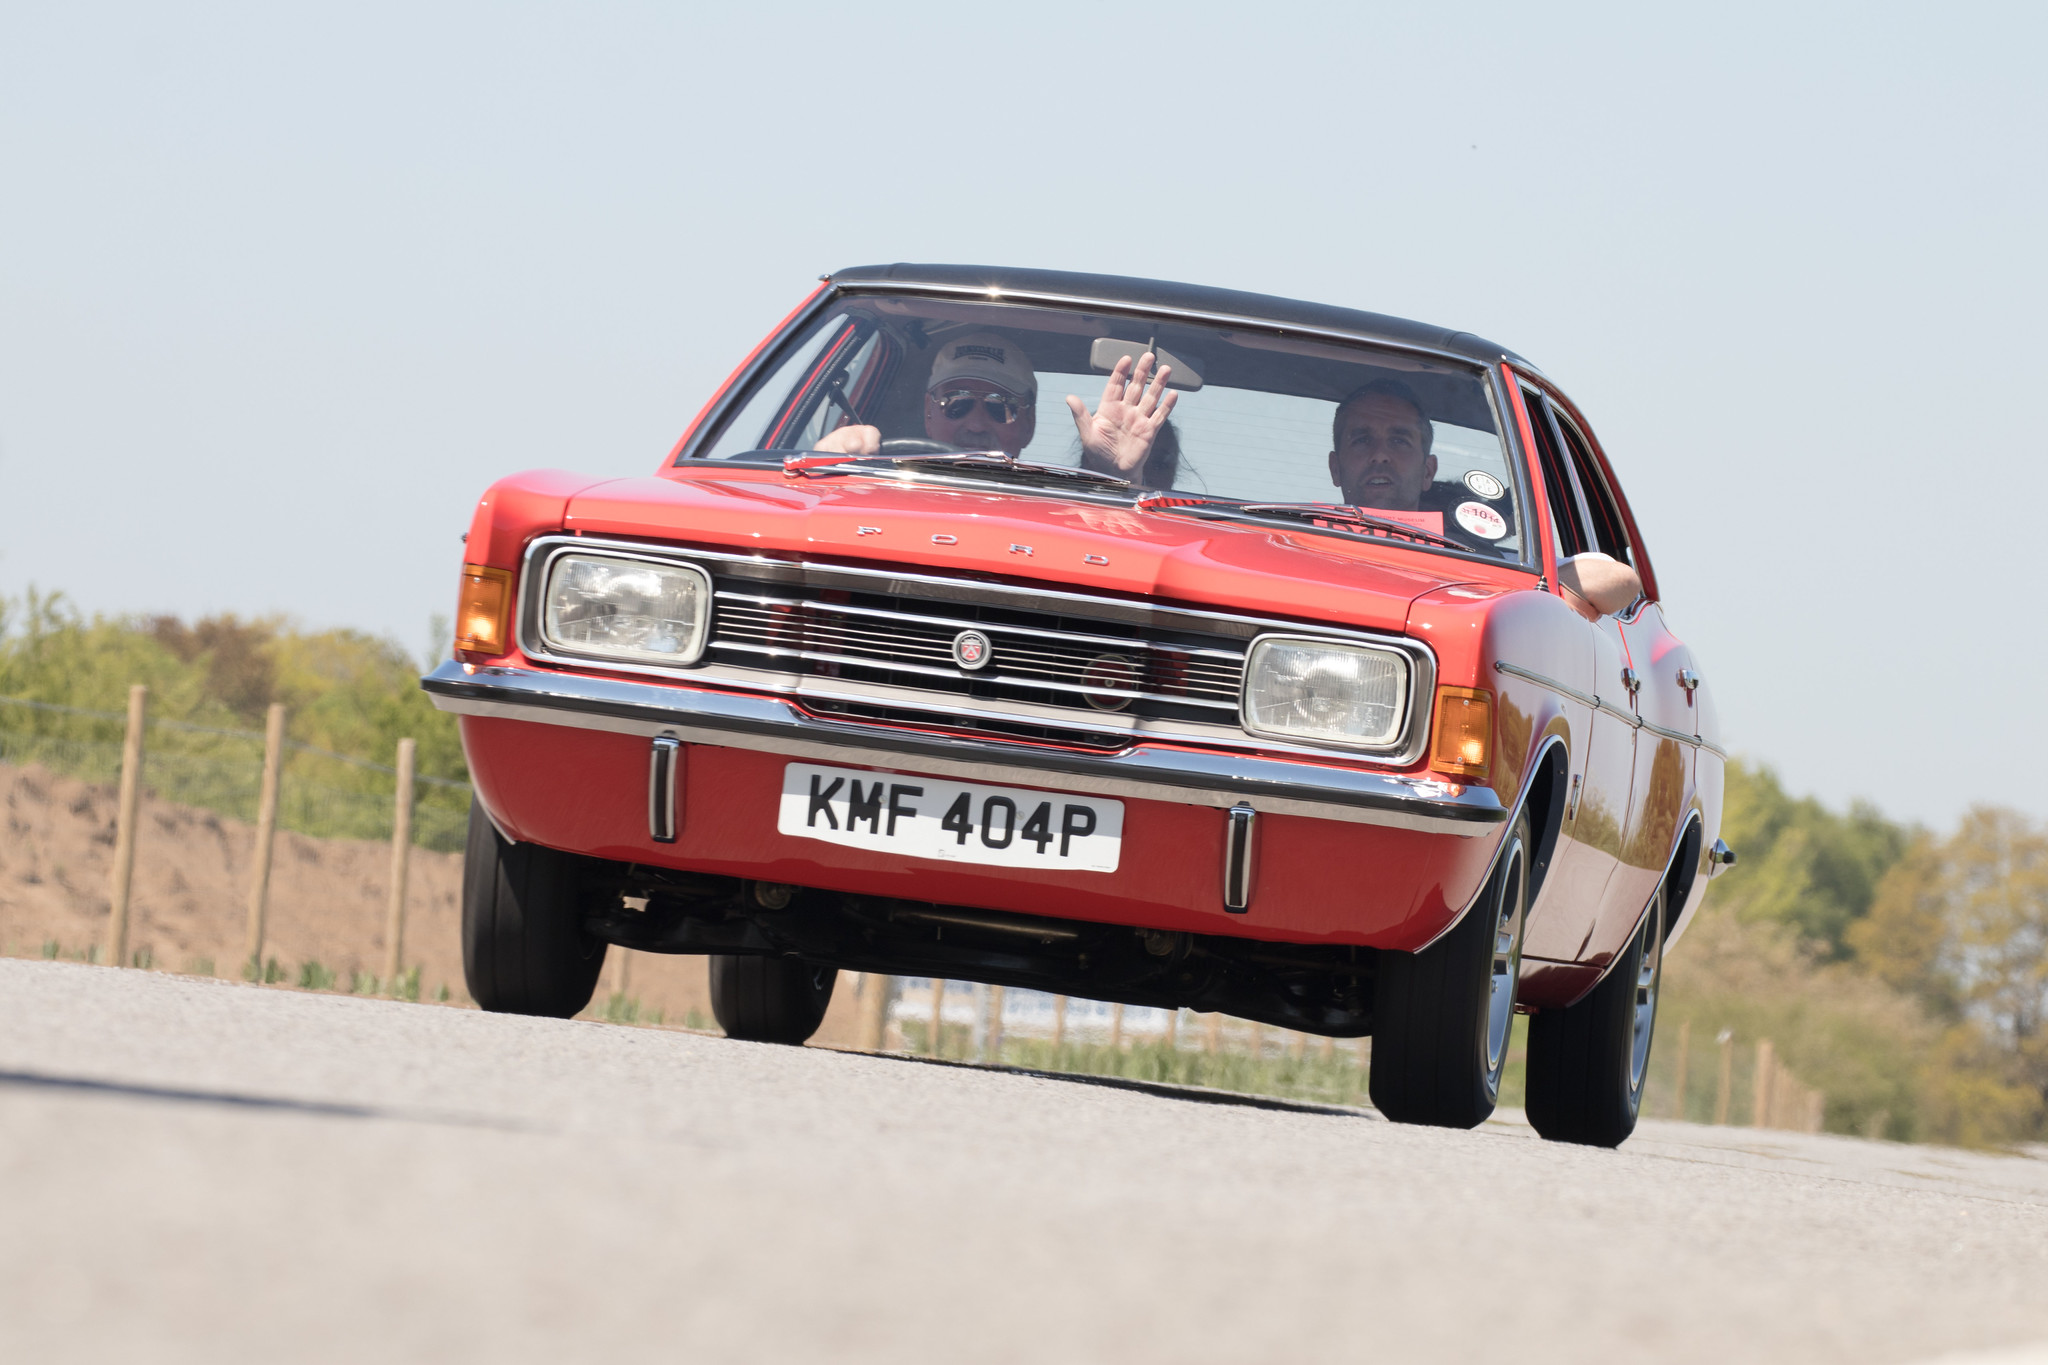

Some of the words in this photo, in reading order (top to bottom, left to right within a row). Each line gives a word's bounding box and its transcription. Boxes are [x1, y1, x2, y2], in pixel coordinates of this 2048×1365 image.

[1472, 508, 1487, 519] 10
[856, 525, 1110, 566] FORD
[808, 774, 924, 836] KMF
[941, 791, 1097, 857] 404P
